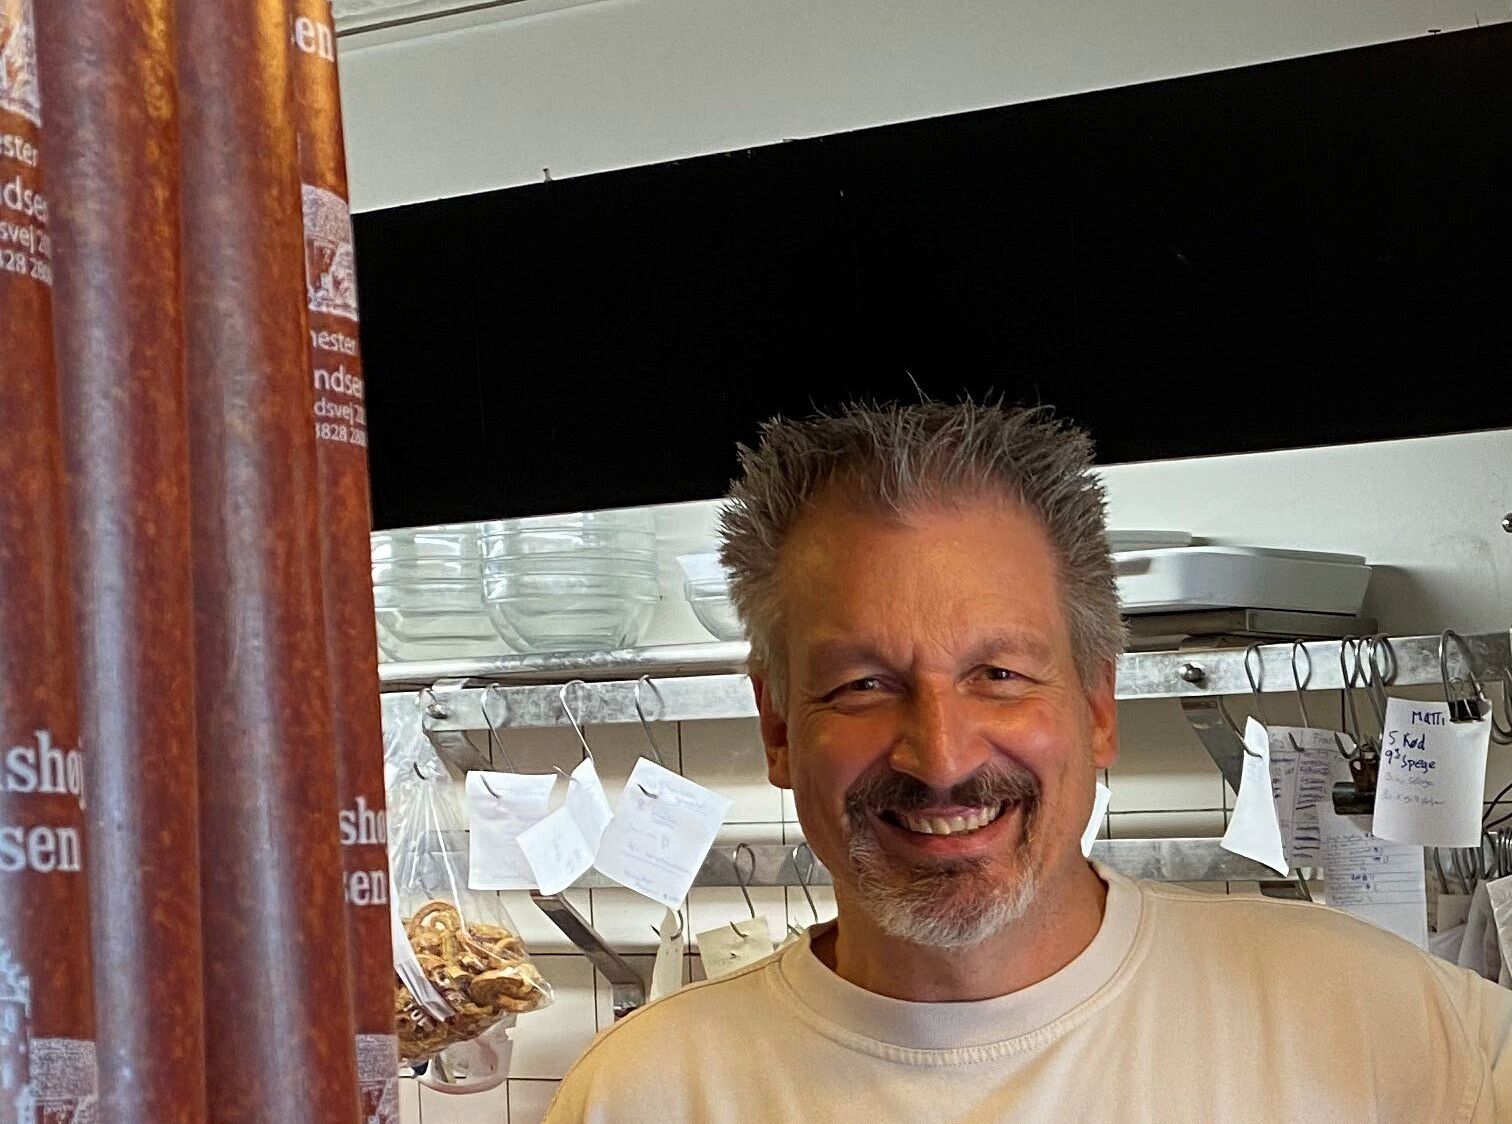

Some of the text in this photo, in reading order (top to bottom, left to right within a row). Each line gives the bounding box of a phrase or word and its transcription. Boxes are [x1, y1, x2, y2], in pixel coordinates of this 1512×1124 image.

[289, 13, 335, 62] en
[0, 826, 81, 873] sen
[343, 869, 388, 906] en
